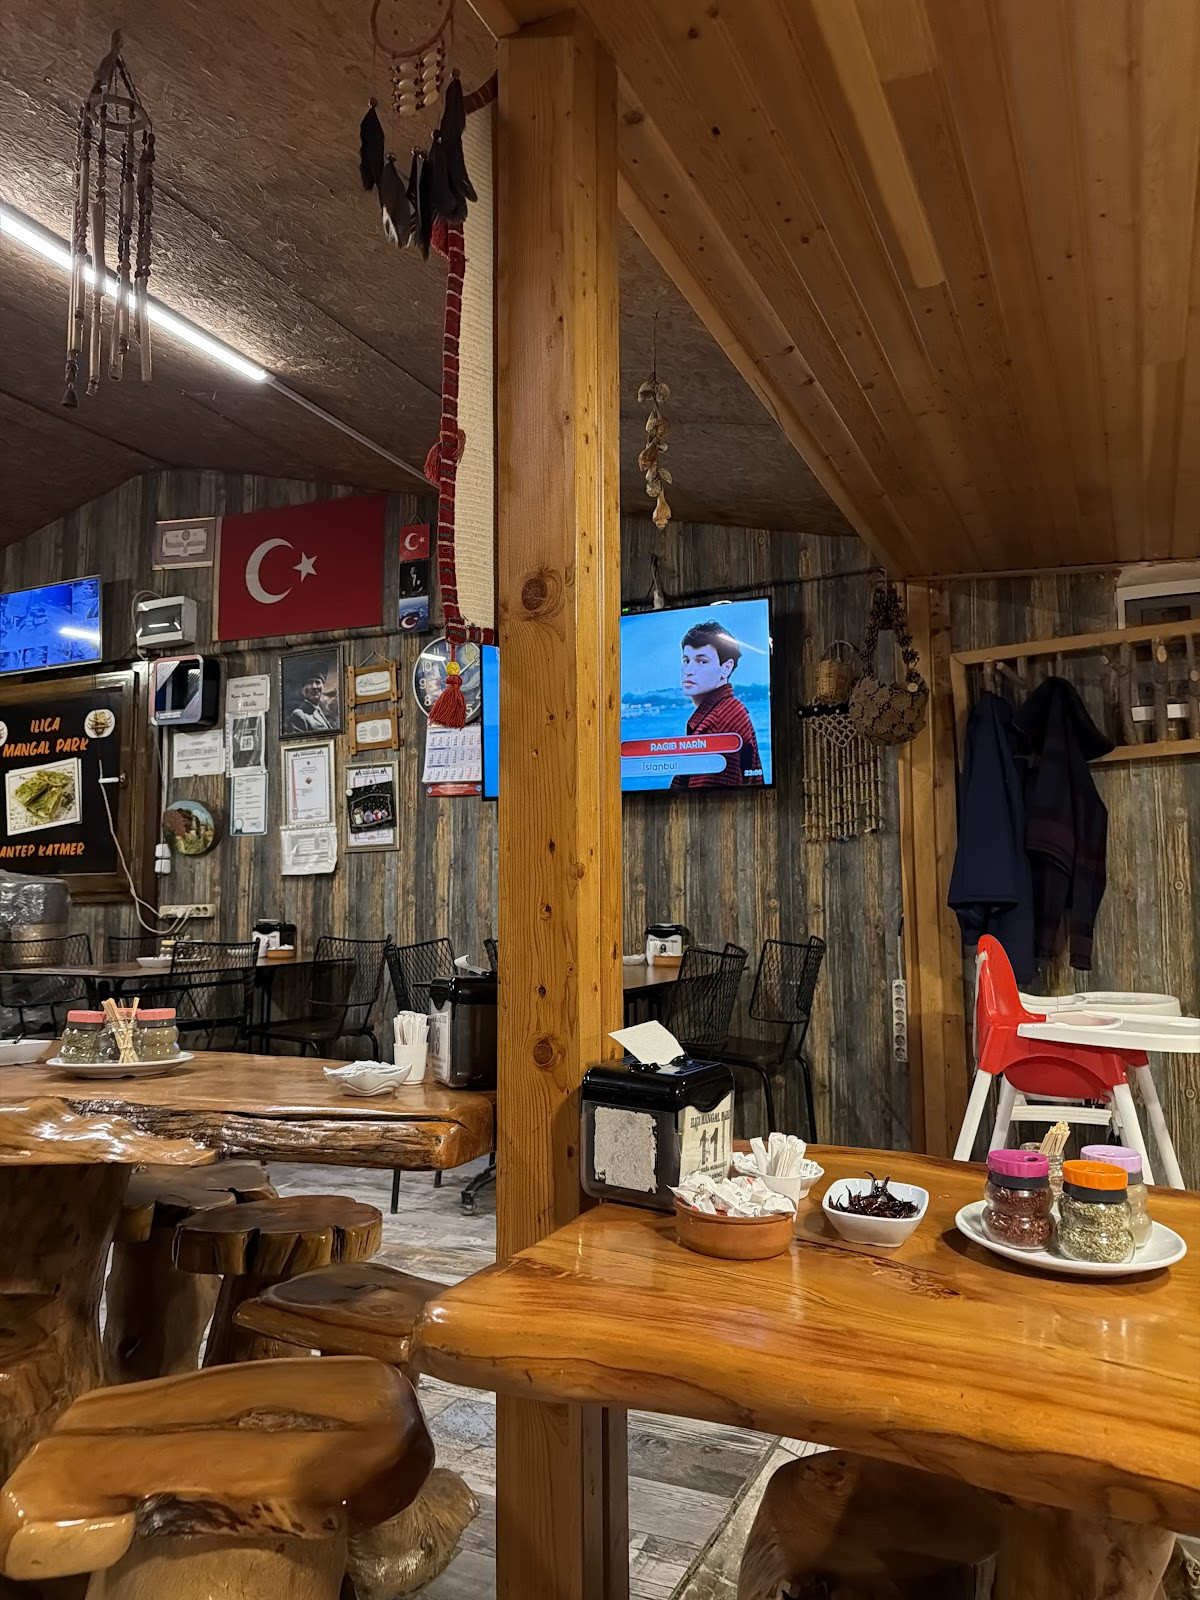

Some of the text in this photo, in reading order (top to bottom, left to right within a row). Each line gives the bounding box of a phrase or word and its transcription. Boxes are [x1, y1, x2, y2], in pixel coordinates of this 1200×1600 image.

[423, 660, 432, 673] 10
[419, 677, 427, 690] 9
[424, 694, 432, 707] 8
[31, 717, 60, 733] ILICA
[3, 738, 89, 757] MANGAL PARK
[650, 738, 707, 752] RAGIB NARİN
[642, 761, 678, 771] İstanbul
[38, 842, 85, 857] KATMER
[700, 1127, 718, 1165] 11
